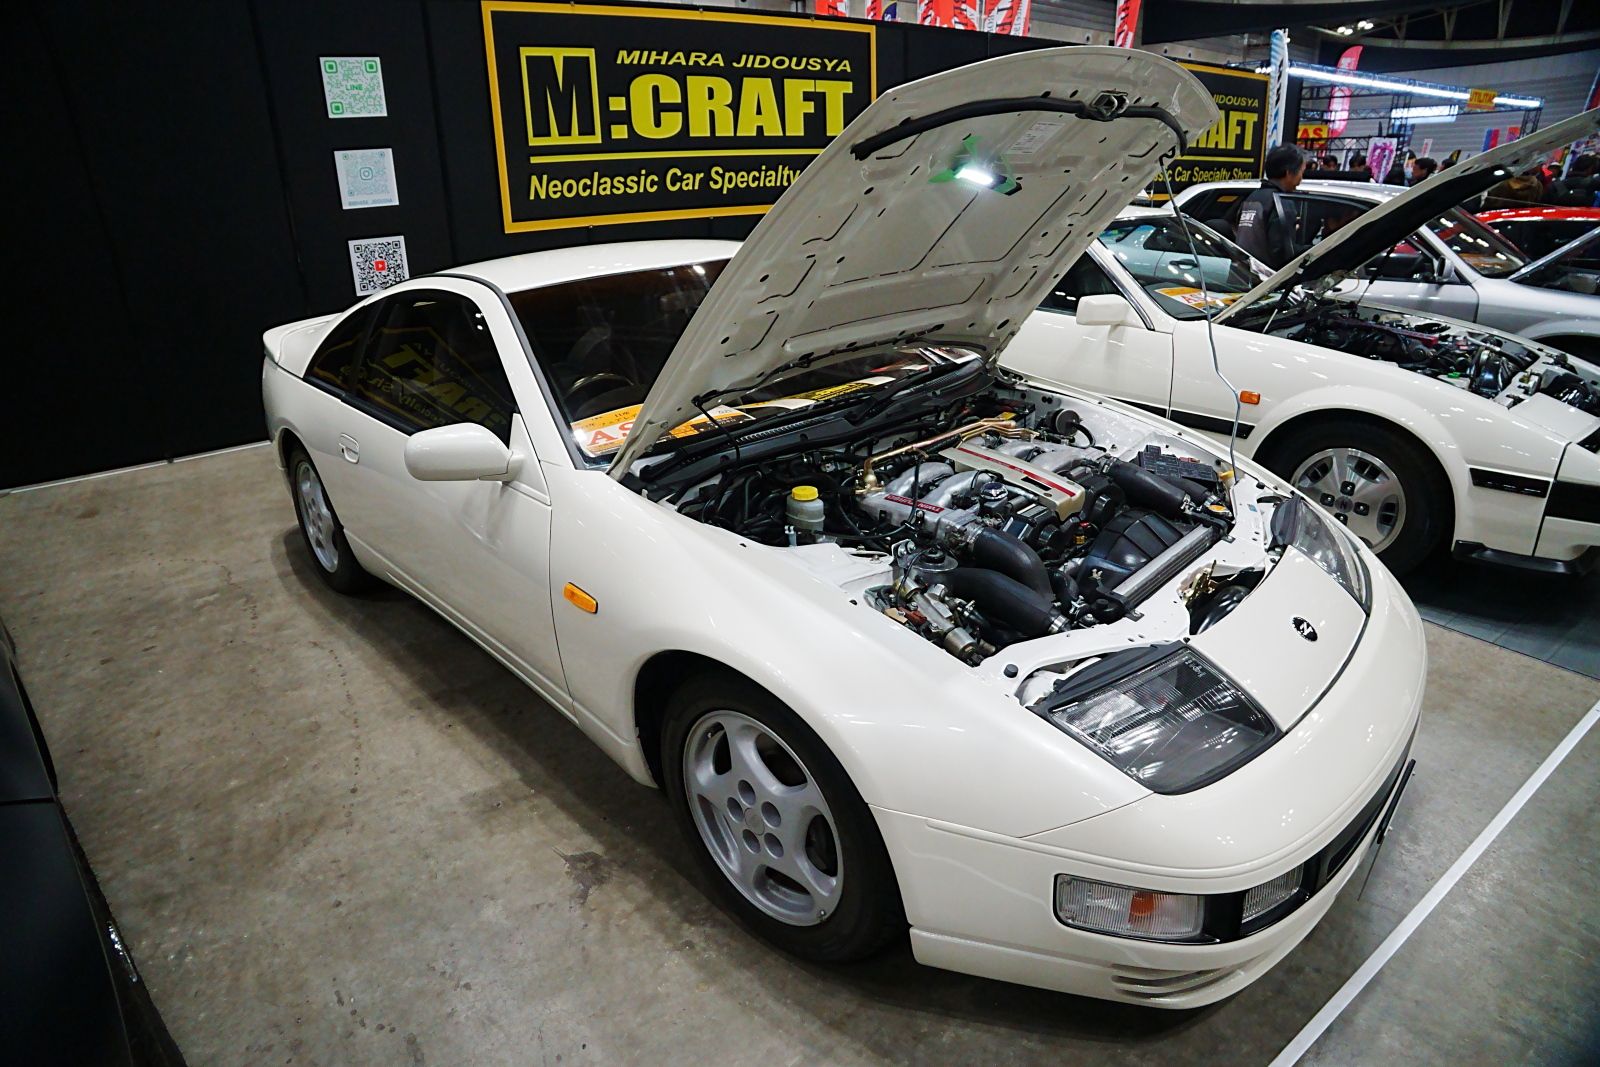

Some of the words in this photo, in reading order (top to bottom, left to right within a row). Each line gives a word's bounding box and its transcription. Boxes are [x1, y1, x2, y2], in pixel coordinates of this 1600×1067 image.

[616, 49, 725, 67] MIHARA
[732, 54, 852, 73] JIDOUSYA
[529, 168, 658, 200] Neoclassic
[665, 167, 702, 192] Car
[1175, 166, 1191, 183] Car
[1192, 166, 1230, 184] Specialty
